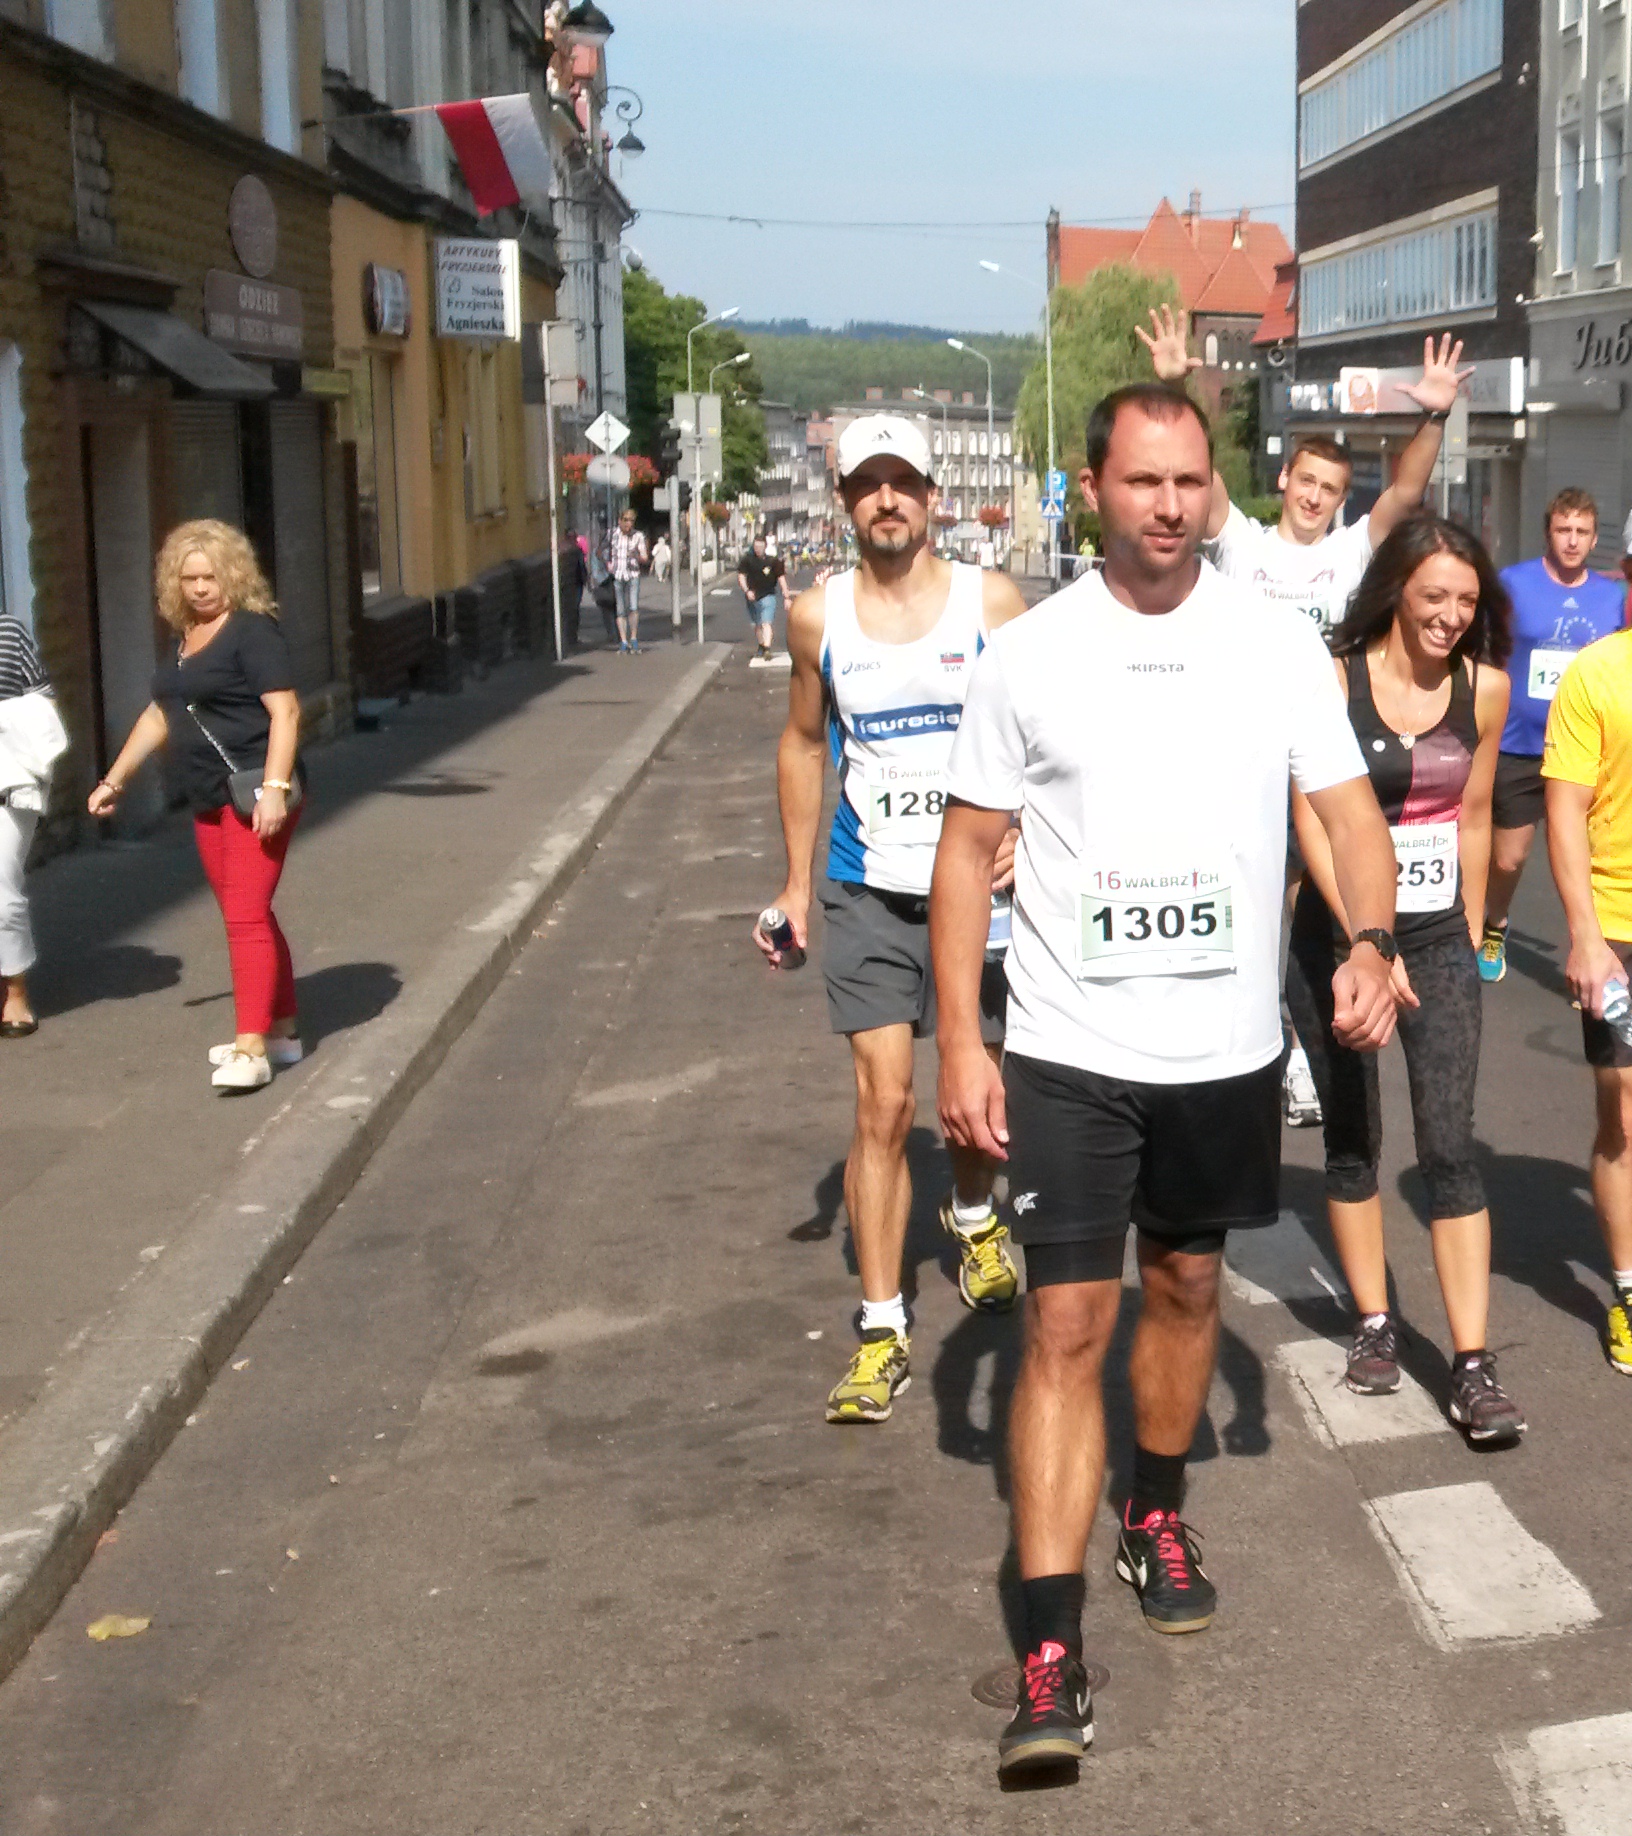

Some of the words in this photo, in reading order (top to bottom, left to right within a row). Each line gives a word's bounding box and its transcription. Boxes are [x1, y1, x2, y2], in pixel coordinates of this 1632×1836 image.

[879, 766, 898, 780] 16
[1093, 871, 1121, 890] 16
[1092, 901, 1217, 942] 1305
